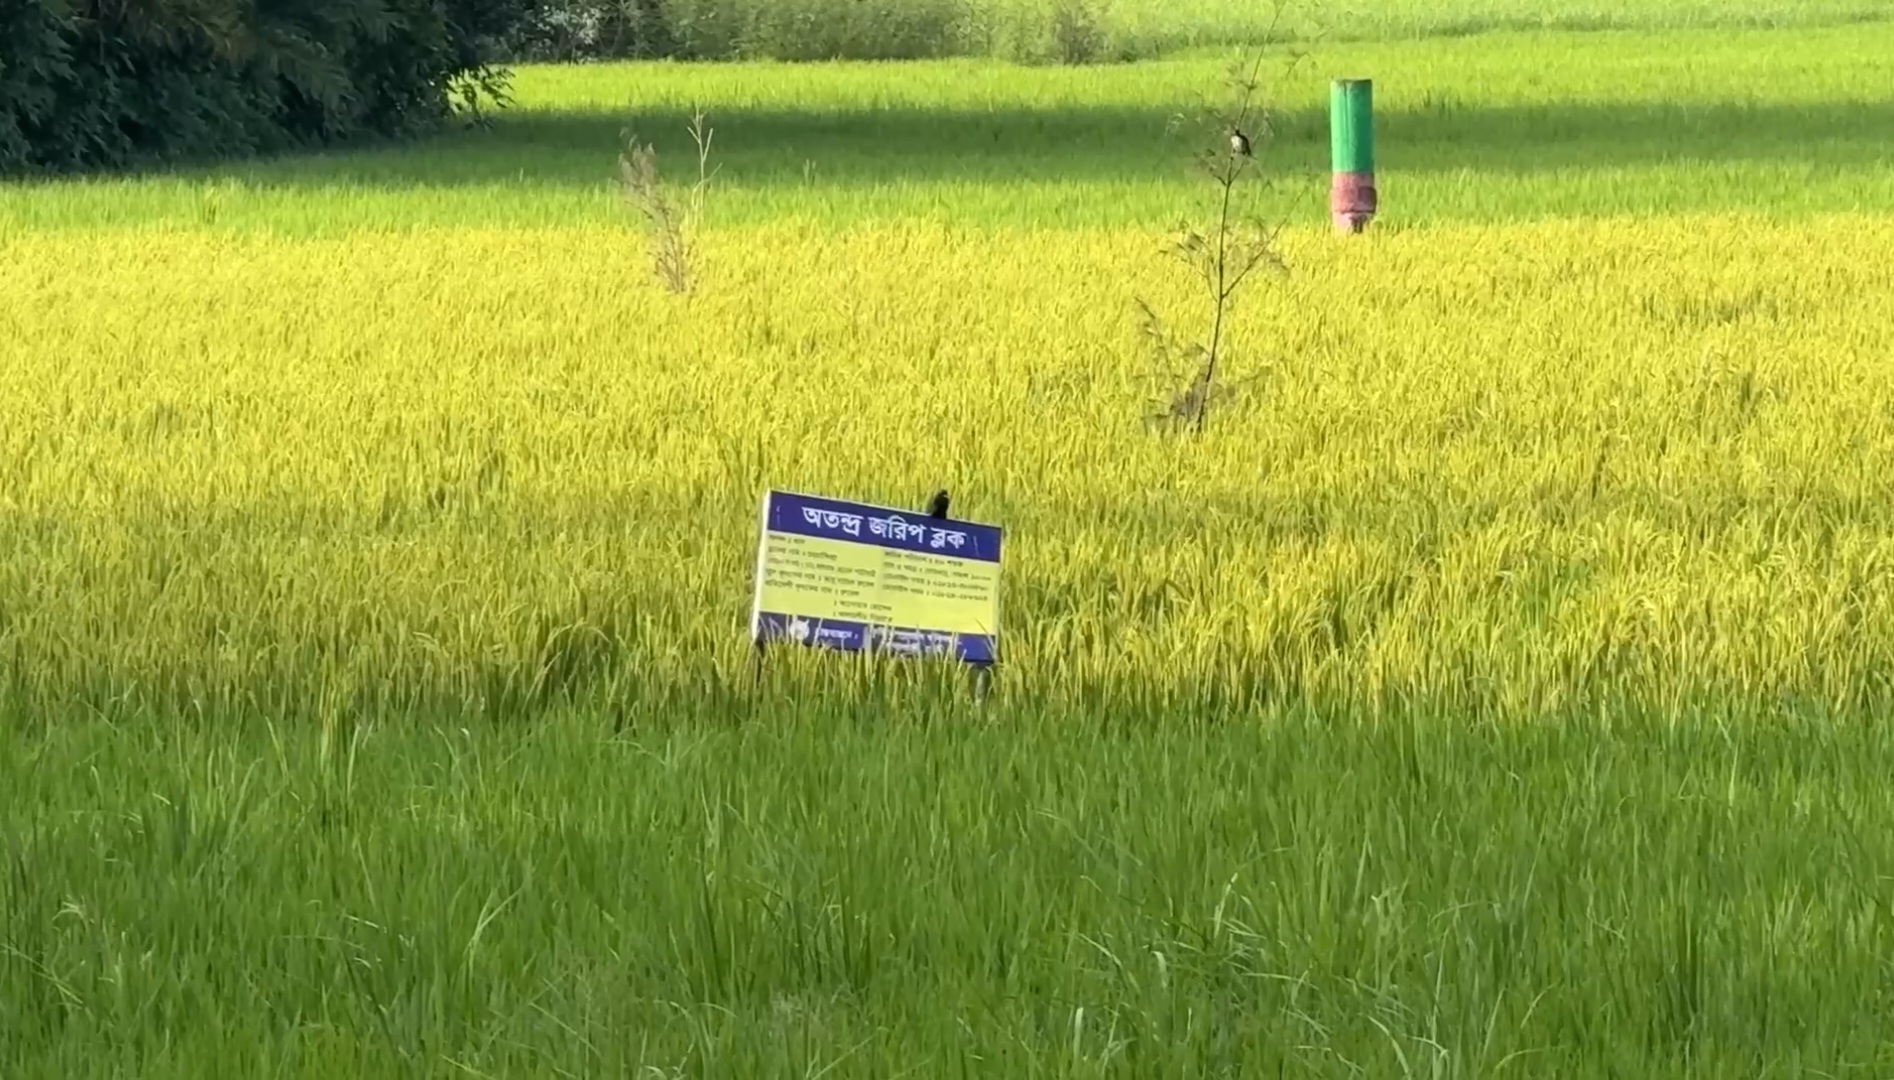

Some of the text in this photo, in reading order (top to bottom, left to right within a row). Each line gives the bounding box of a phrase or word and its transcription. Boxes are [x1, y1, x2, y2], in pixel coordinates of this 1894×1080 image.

[801, 506, 967, 549] অতন্দ্র জরিপ ব্লক
